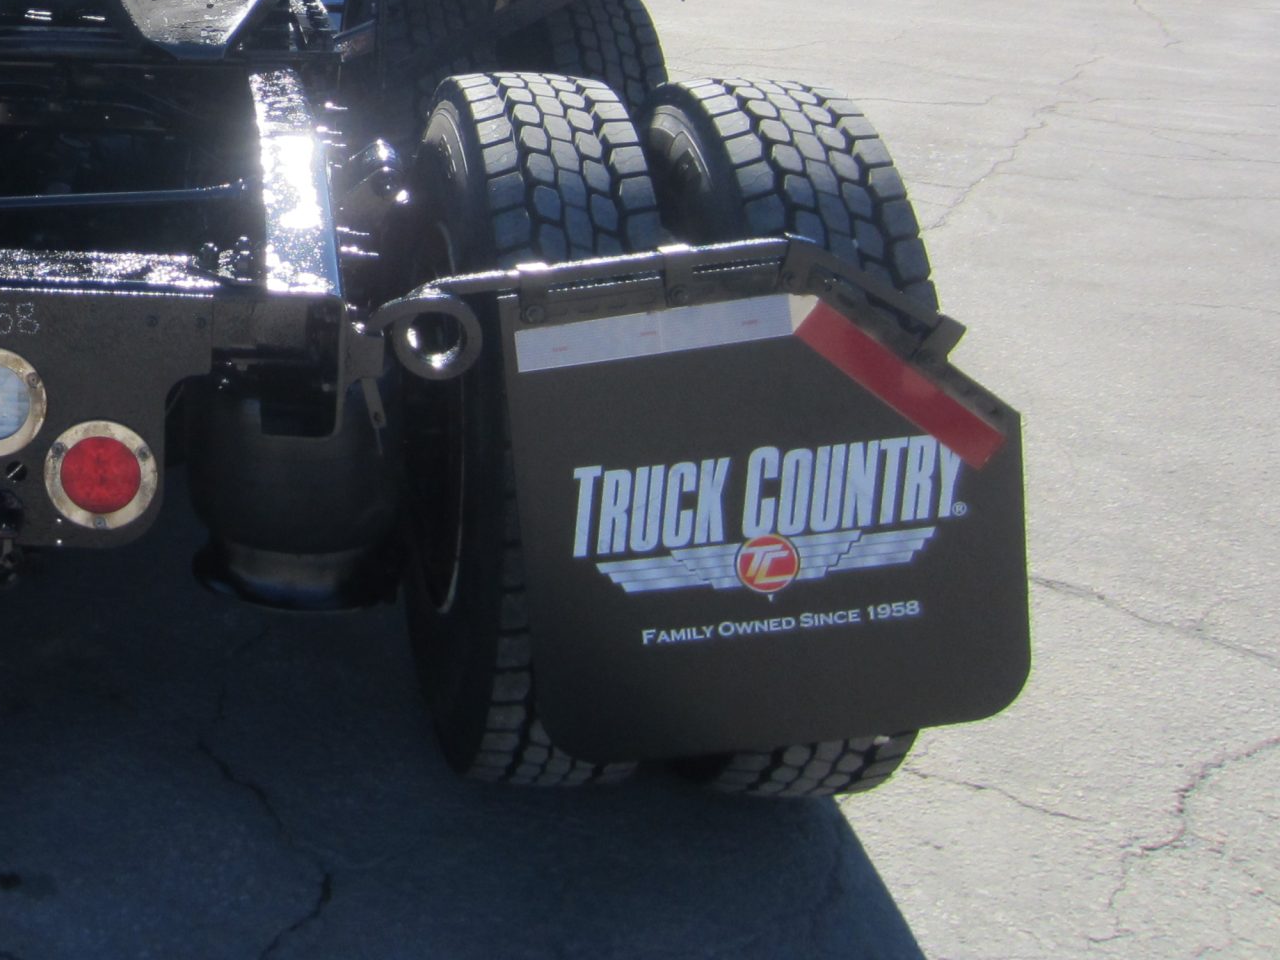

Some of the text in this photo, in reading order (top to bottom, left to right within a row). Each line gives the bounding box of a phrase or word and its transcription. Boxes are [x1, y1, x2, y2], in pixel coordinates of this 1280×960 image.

[573, 457, 731, 558] TRUCK
[641, 600, 921, 645] FAMILY OWNED SINCE 1958
